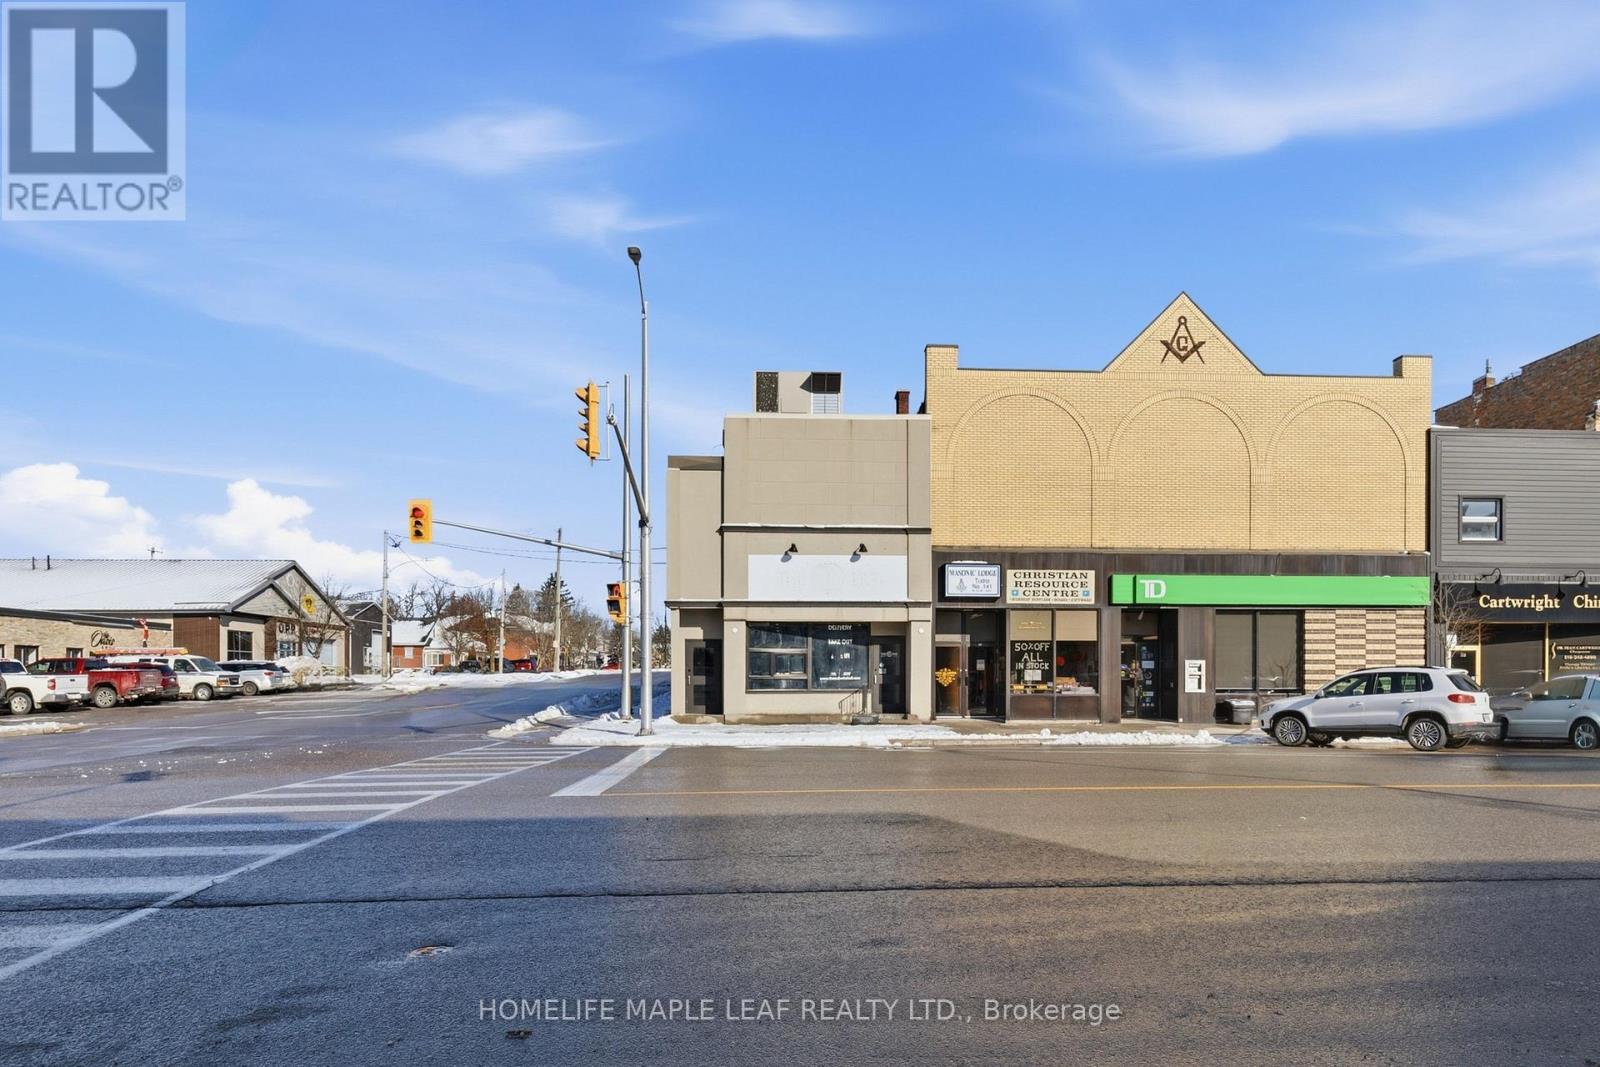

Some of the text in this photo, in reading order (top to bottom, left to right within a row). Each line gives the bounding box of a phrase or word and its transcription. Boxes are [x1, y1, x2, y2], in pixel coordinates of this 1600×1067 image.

[949, 569, 997, 577] MASONIC LODGE
[1013, 571, 1089, 579] CHRISTIAN
[1014, 580, 1088, 589] RESOURCE
[1139, 579, 1167, 599] TD
[1022, 589, 1079, 598] CENTRE
[1479, 594, 1561, 612] Cartwright
[1021, 652, 1044, 663] ALL
[1015, 662, 1050, 671] IN STOCK
